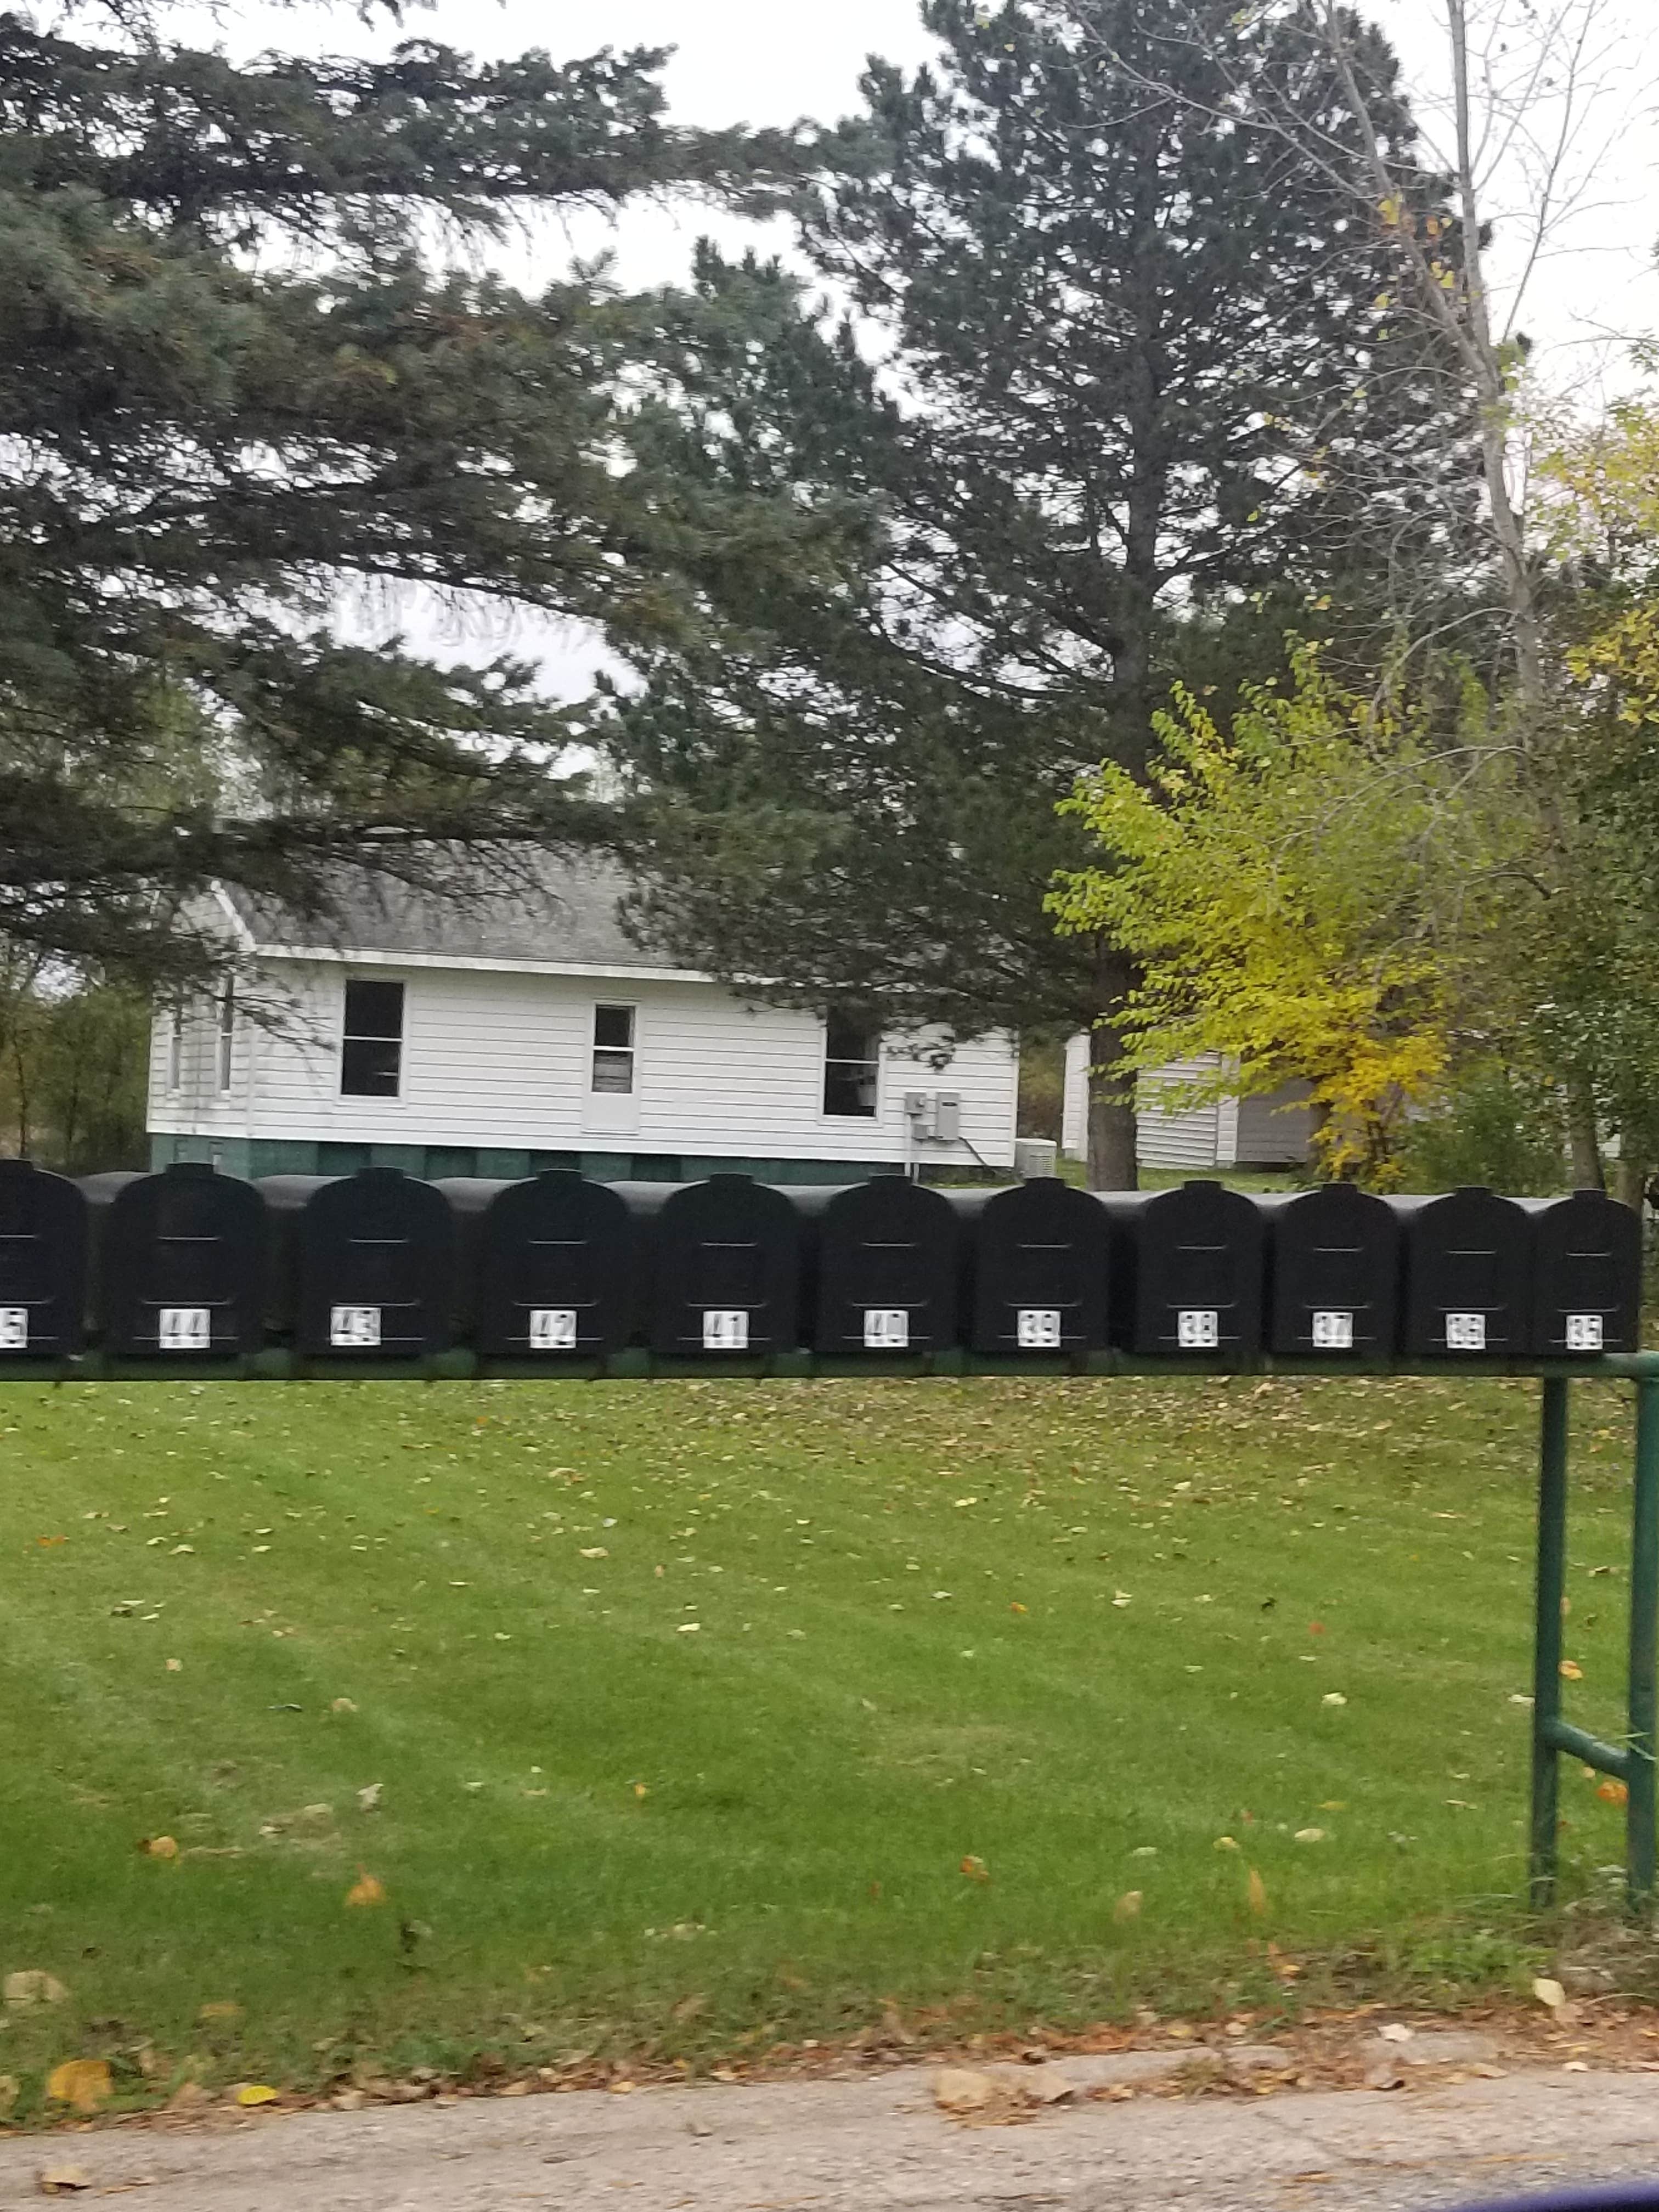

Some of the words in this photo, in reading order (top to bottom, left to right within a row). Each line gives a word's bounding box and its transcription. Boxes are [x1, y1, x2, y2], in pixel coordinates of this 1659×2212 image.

[533, 1313, 574, 1346] 42
[706, 1313, 745, 1346] 41
[866, 1313, 906, 1345] 40
[1181, 1314, 1216, 1344] 38
[1315, 1314, 1350, 1345] 37
[1568, 1317, 1601, 1347] 35
